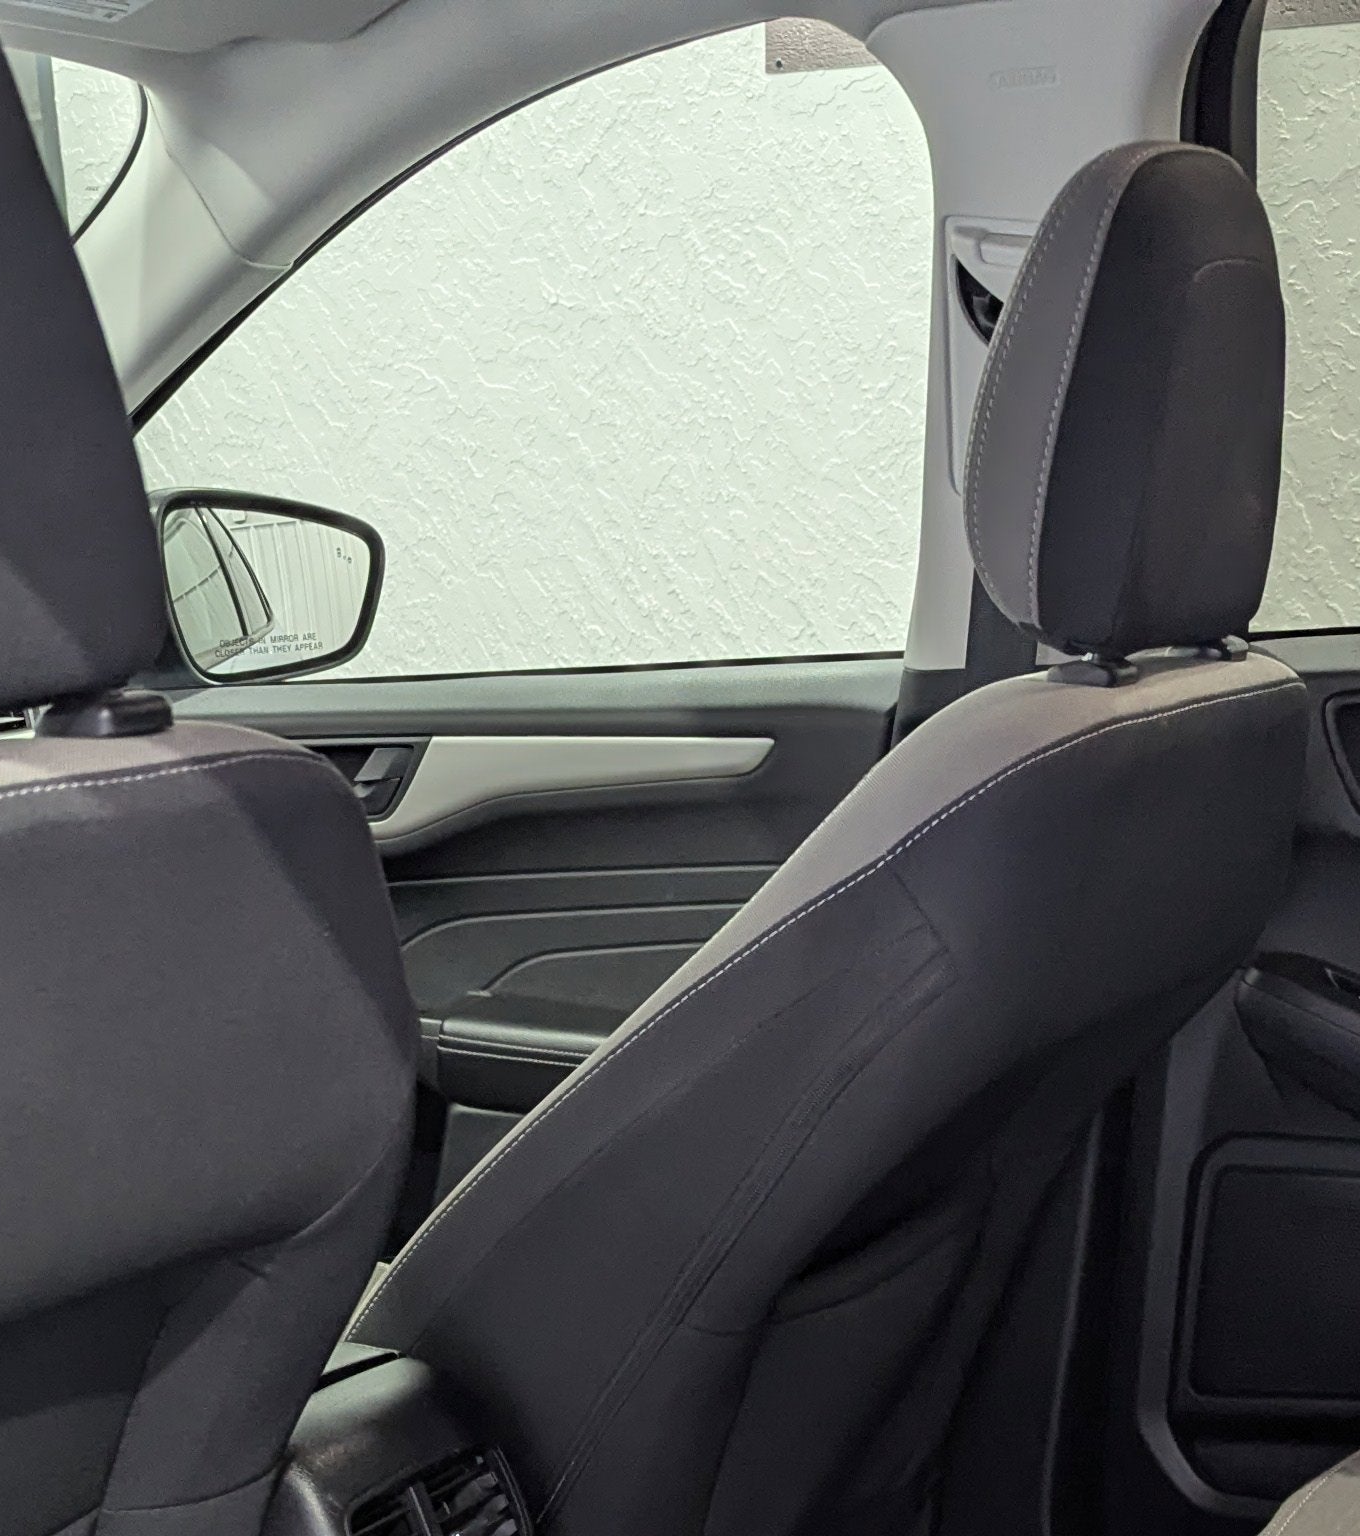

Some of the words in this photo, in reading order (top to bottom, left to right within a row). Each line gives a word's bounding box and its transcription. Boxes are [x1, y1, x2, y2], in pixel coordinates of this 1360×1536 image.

[270, 634, 299, 644] MIRROR
[302, 632, 318, 641] ARE
[249, 646, 269, 655] THAN
[272, 644, 291, 653] THEY
[294, 641, 324, 651] APPEAR
